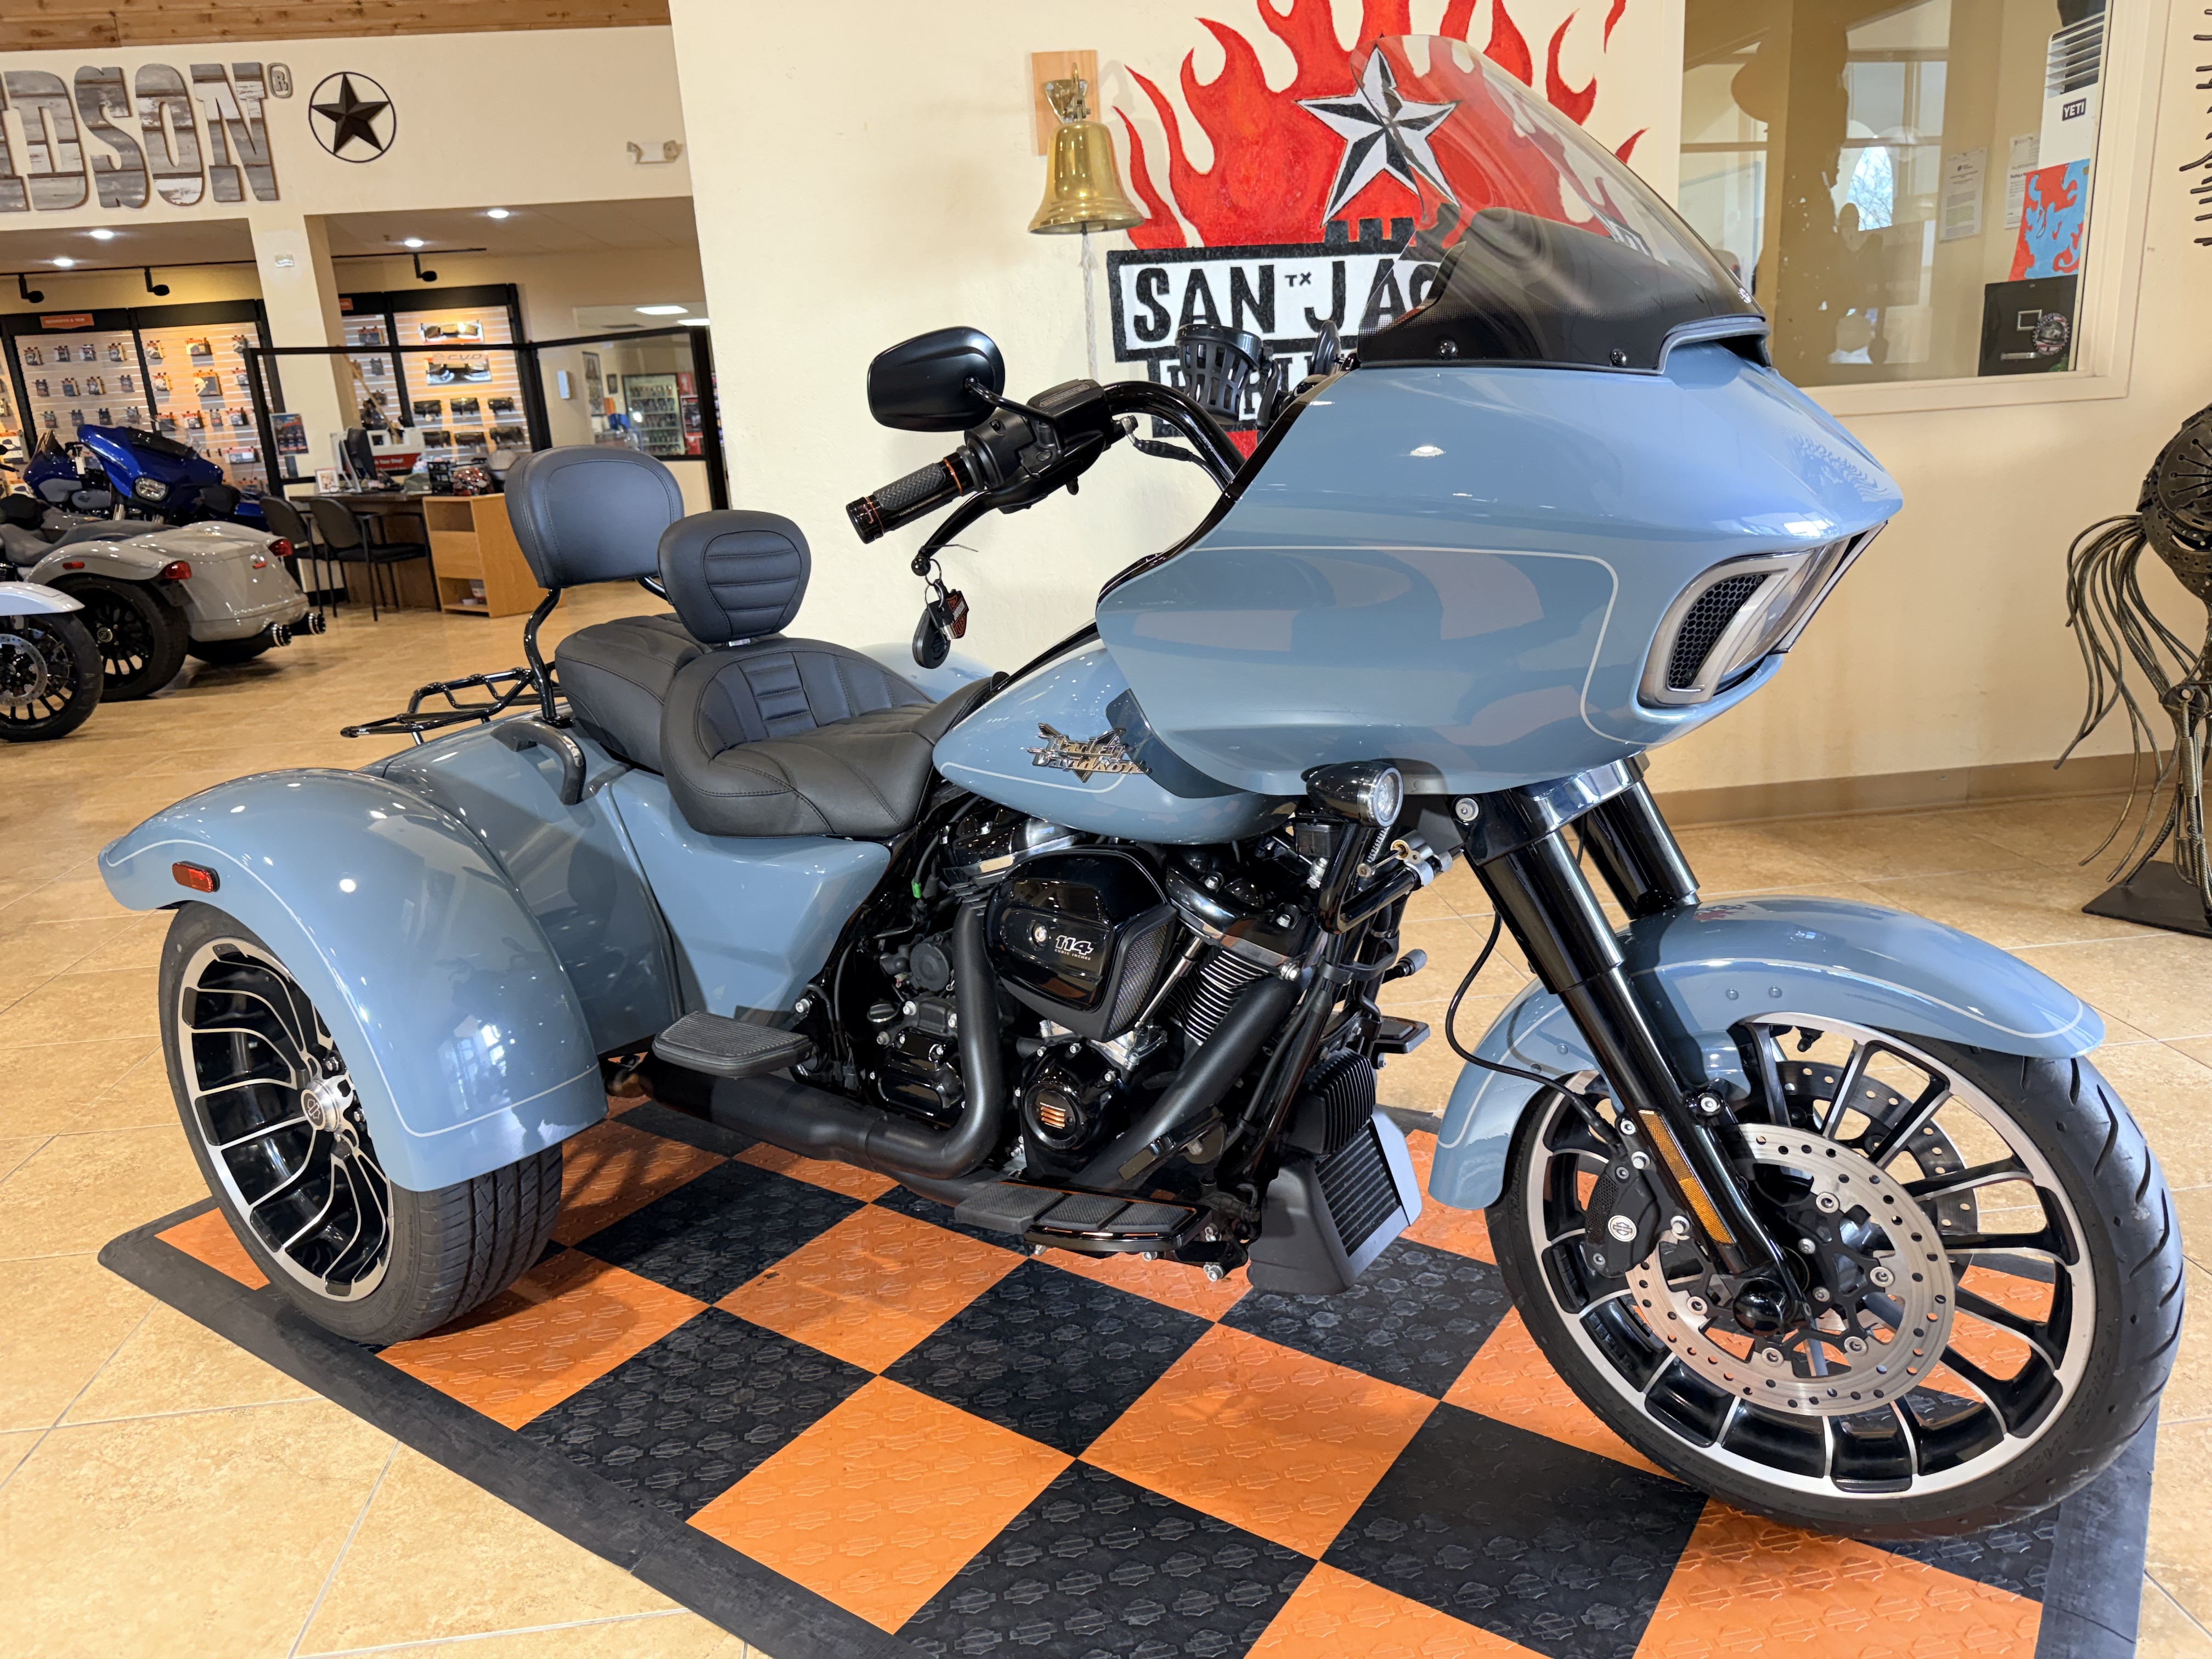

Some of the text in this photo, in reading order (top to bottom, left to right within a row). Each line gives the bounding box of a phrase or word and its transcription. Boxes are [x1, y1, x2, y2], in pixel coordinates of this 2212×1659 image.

[2064, 101, 2085, 117] YETI
[1134, 264, 1274, 342] SAN
[1285, 272, 1311, 287] TX
[1056, 935, 1094, 955] 114
